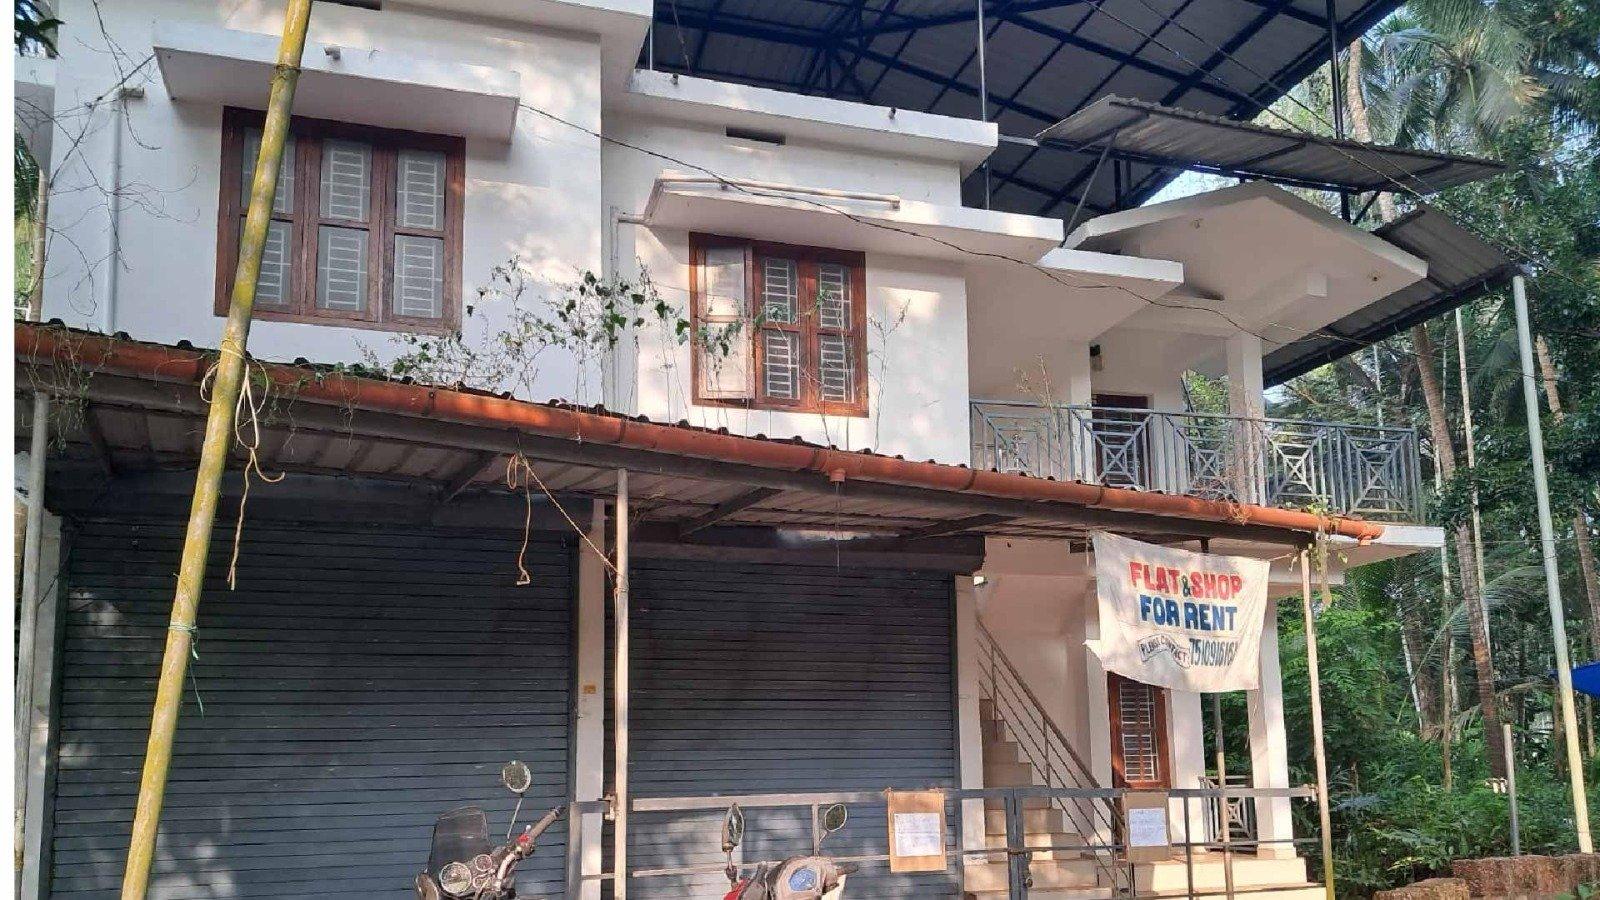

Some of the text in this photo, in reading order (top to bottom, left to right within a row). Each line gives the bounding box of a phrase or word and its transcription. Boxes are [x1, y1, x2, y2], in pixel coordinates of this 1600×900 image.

[1129, 561, 1180, 594] FLAT
[1190, 571, 1243, 600] SHOP
[1140, 594, 1238, 631] FOR RENT
